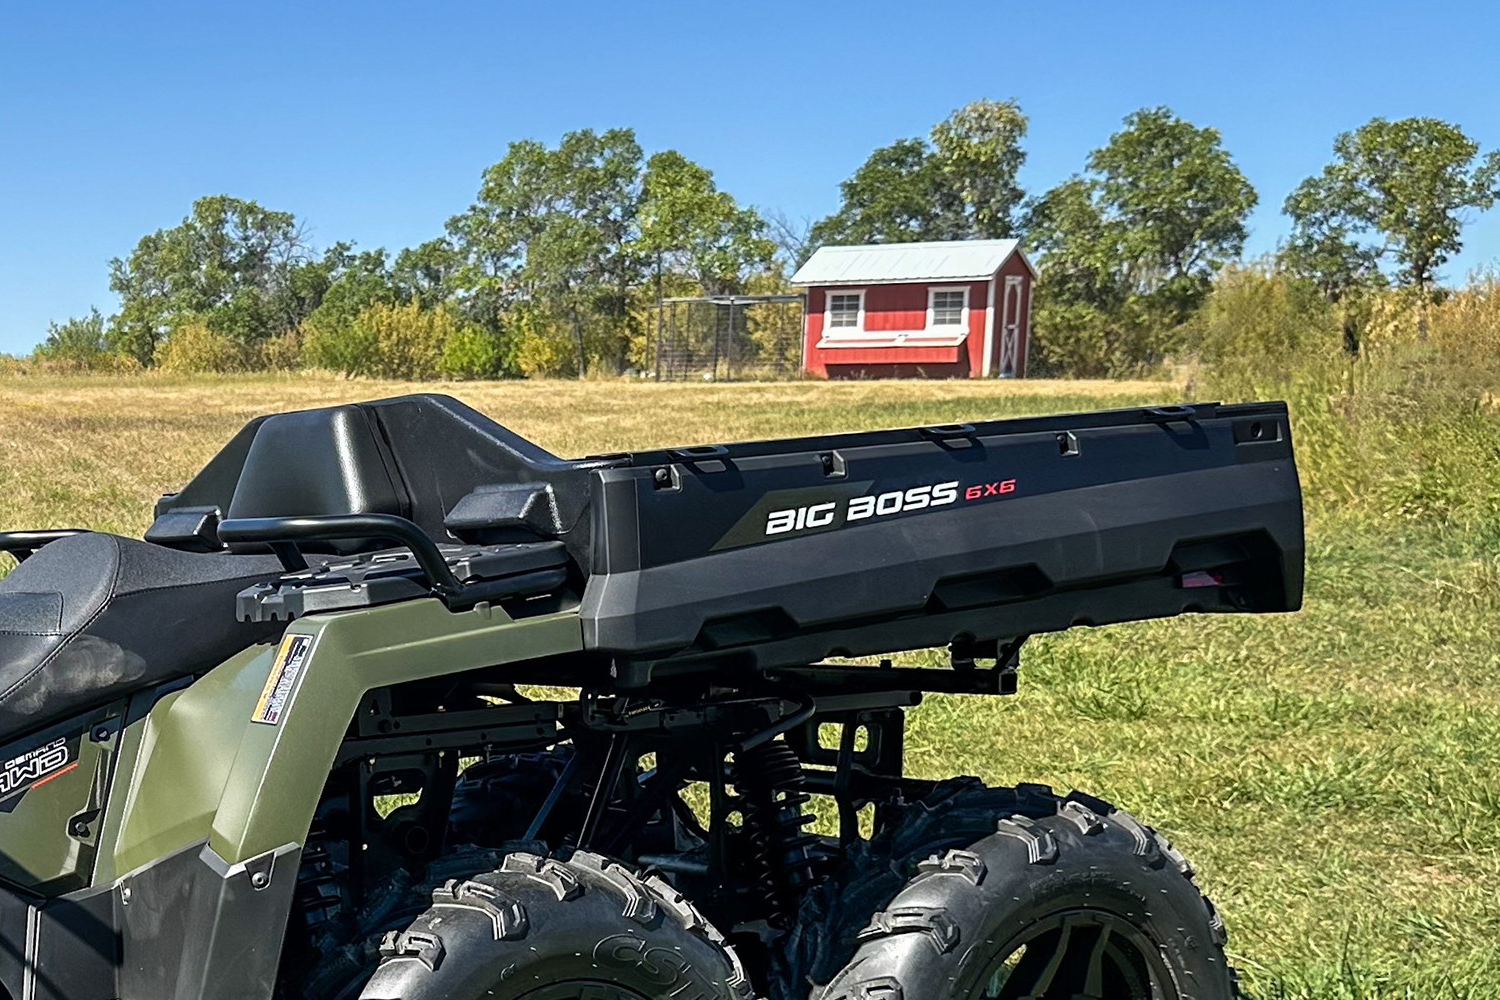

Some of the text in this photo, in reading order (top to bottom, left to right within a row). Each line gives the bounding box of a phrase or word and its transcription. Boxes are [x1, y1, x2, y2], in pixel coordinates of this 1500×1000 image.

[765, 479, 1016, 535] BIG BOSS 6X6
[4, 737, 66, 769] DEMAND
